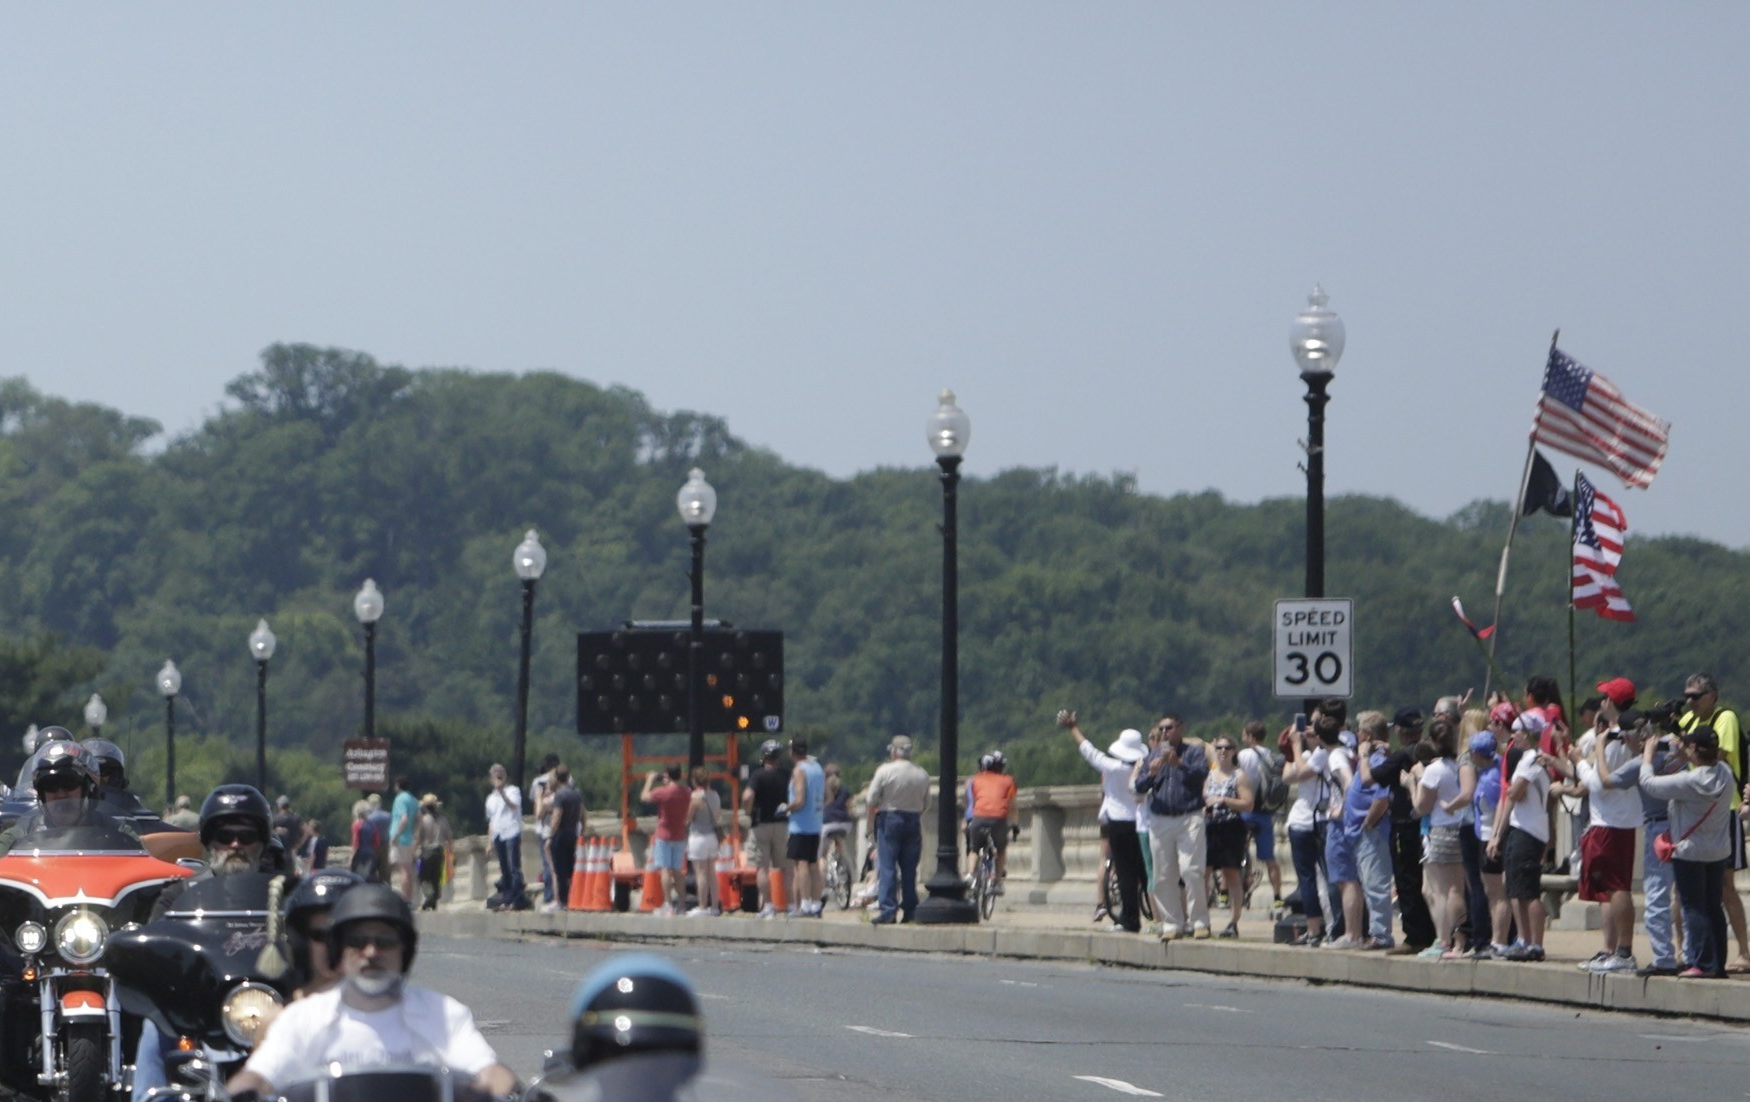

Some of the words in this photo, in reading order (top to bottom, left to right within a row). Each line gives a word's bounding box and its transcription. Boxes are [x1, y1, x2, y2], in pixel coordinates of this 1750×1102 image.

[1283, 610, 1345, 627] SPEED
[1288, 630, 1337, 646] LIMIT
[1285, 651, 1342, 685] 30
